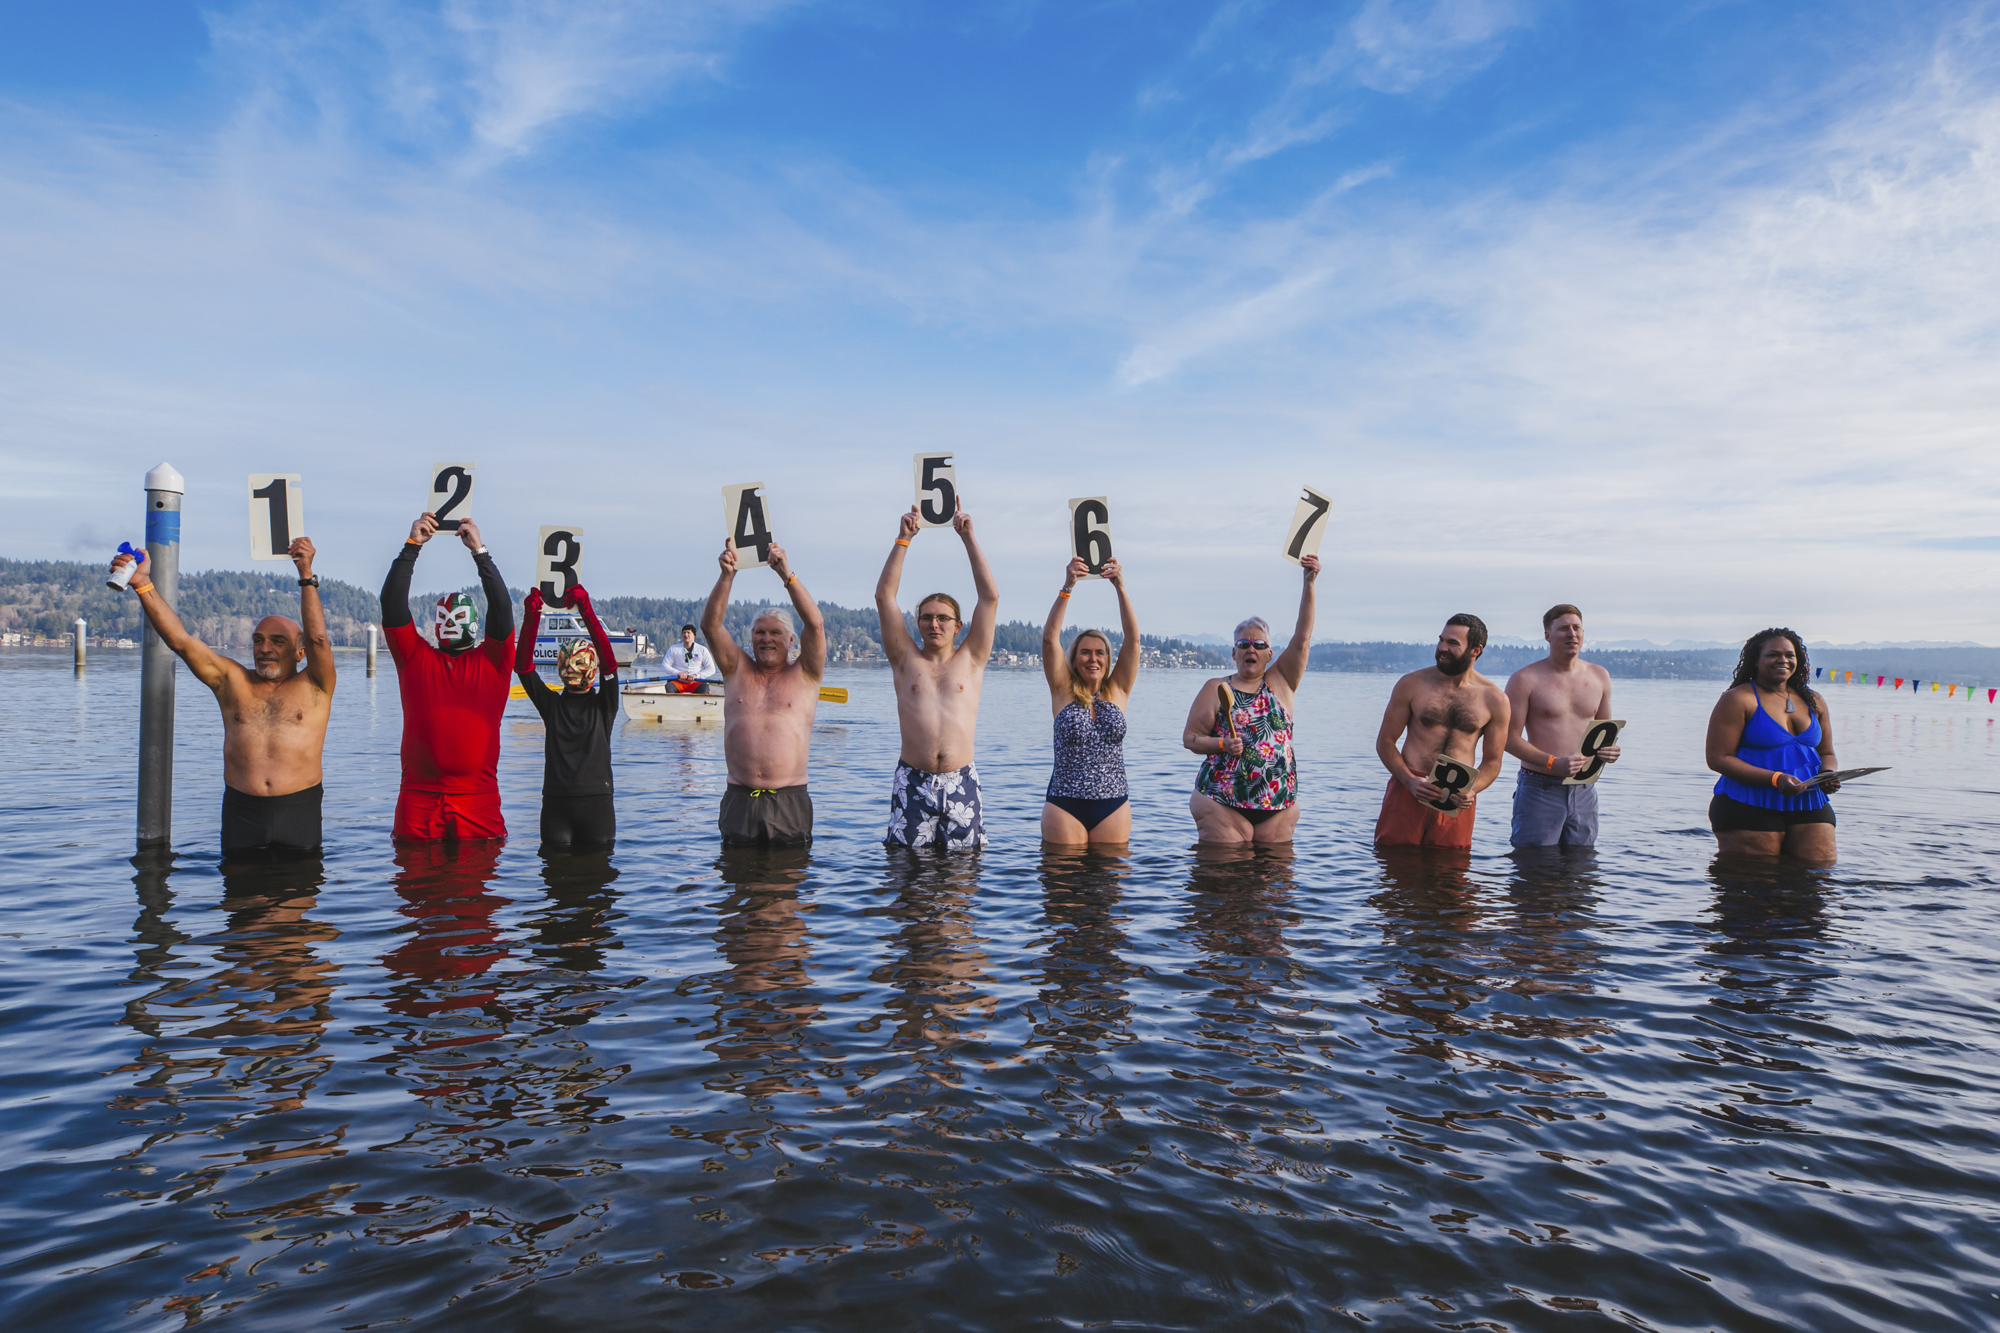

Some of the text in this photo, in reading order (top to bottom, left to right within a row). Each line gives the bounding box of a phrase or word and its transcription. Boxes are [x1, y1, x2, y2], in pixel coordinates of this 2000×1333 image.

[253, 478, 290, 555] 1
[434, 467, 472, 531] 2
[734, 488, 772, 562] 4
[921, 457, 956, 524] 5
[1288, 488, 1329, 559] 7
[541, 531, 581, 608] 3
[1074, 500, 1112, 575] 6
[533, 649, 557, 658] OLICE
[1573, 722, 1619, 781] 9
[1430, 762, 1470, 812] 8
